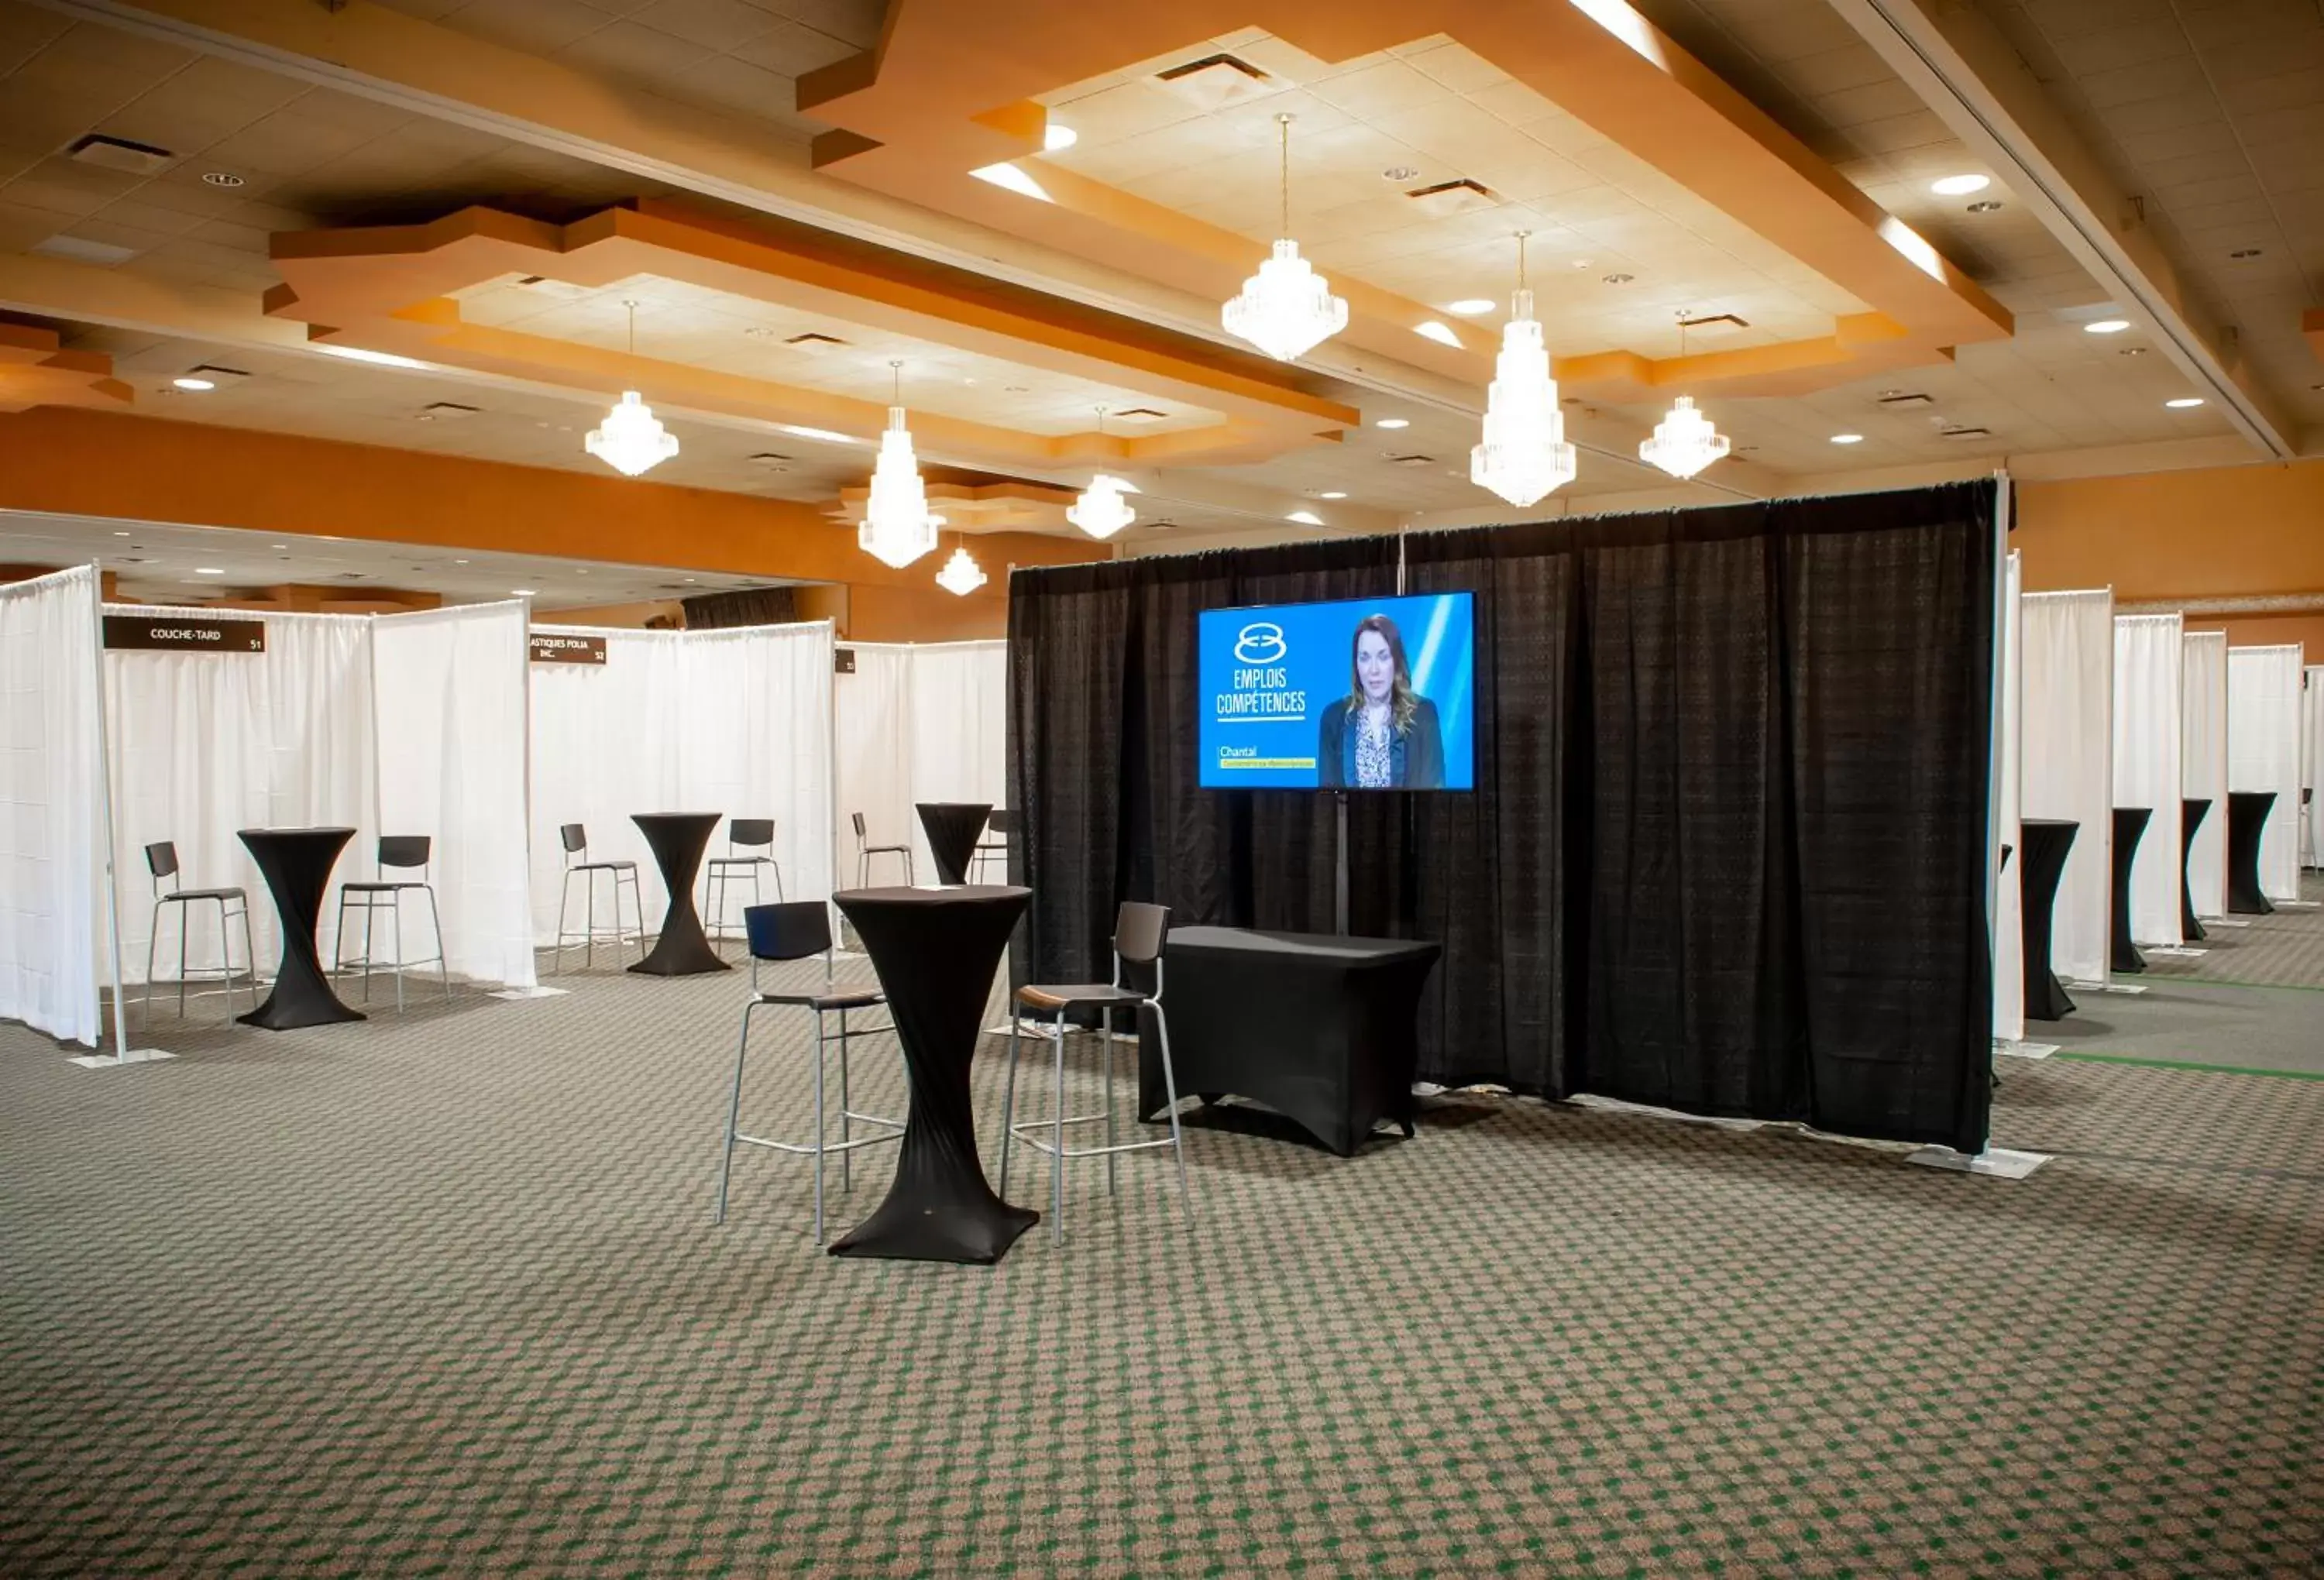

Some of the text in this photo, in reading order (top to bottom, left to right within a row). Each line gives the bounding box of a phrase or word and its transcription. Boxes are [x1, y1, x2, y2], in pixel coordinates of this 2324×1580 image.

[150, 628, 221, 641] COUCHE-TARD
[249, 639, 261, 649] 51
[1234, 667, 1287, 689] EMPLOIS
[1217, 690, 1305, 713] COMPÉTENCES
[1220, 745, 1257, 757] Chantal
